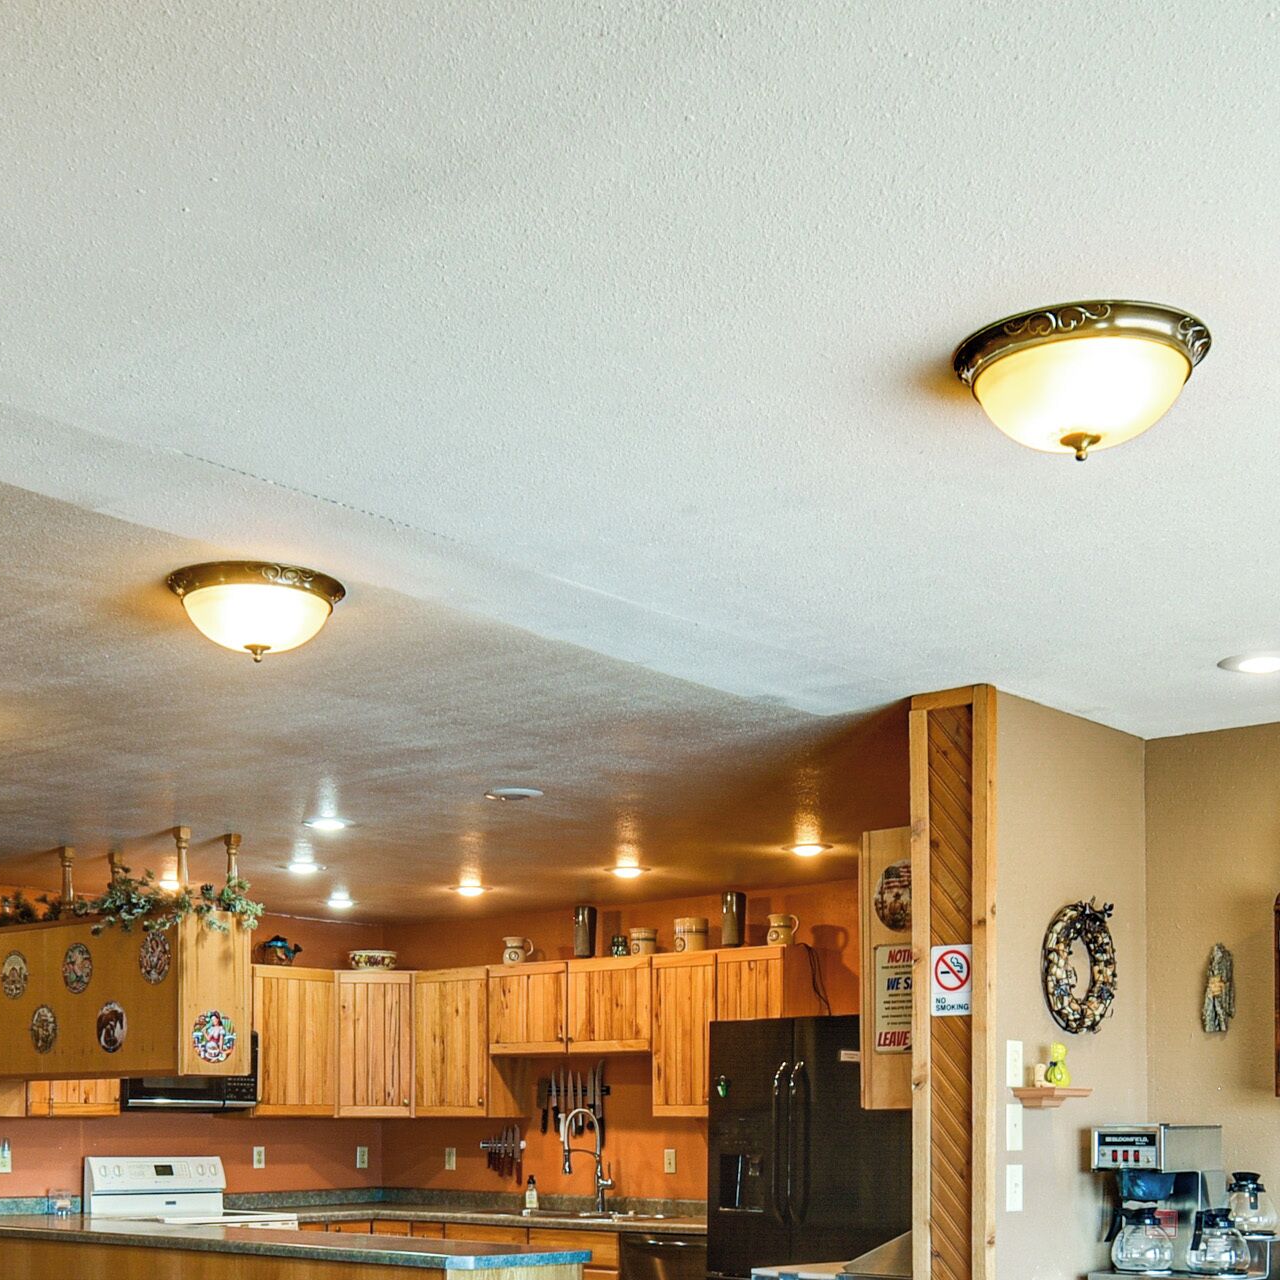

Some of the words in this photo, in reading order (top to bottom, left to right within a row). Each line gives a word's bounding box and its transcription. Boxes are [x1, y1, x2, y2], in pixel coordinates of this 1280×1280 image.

[887, 977, 902, 991] WE
[903, 976, 912, 990] S
[935, 1003, 969, 1011] SMOKING
[878, 1031, 910, 1047] LEAVE
